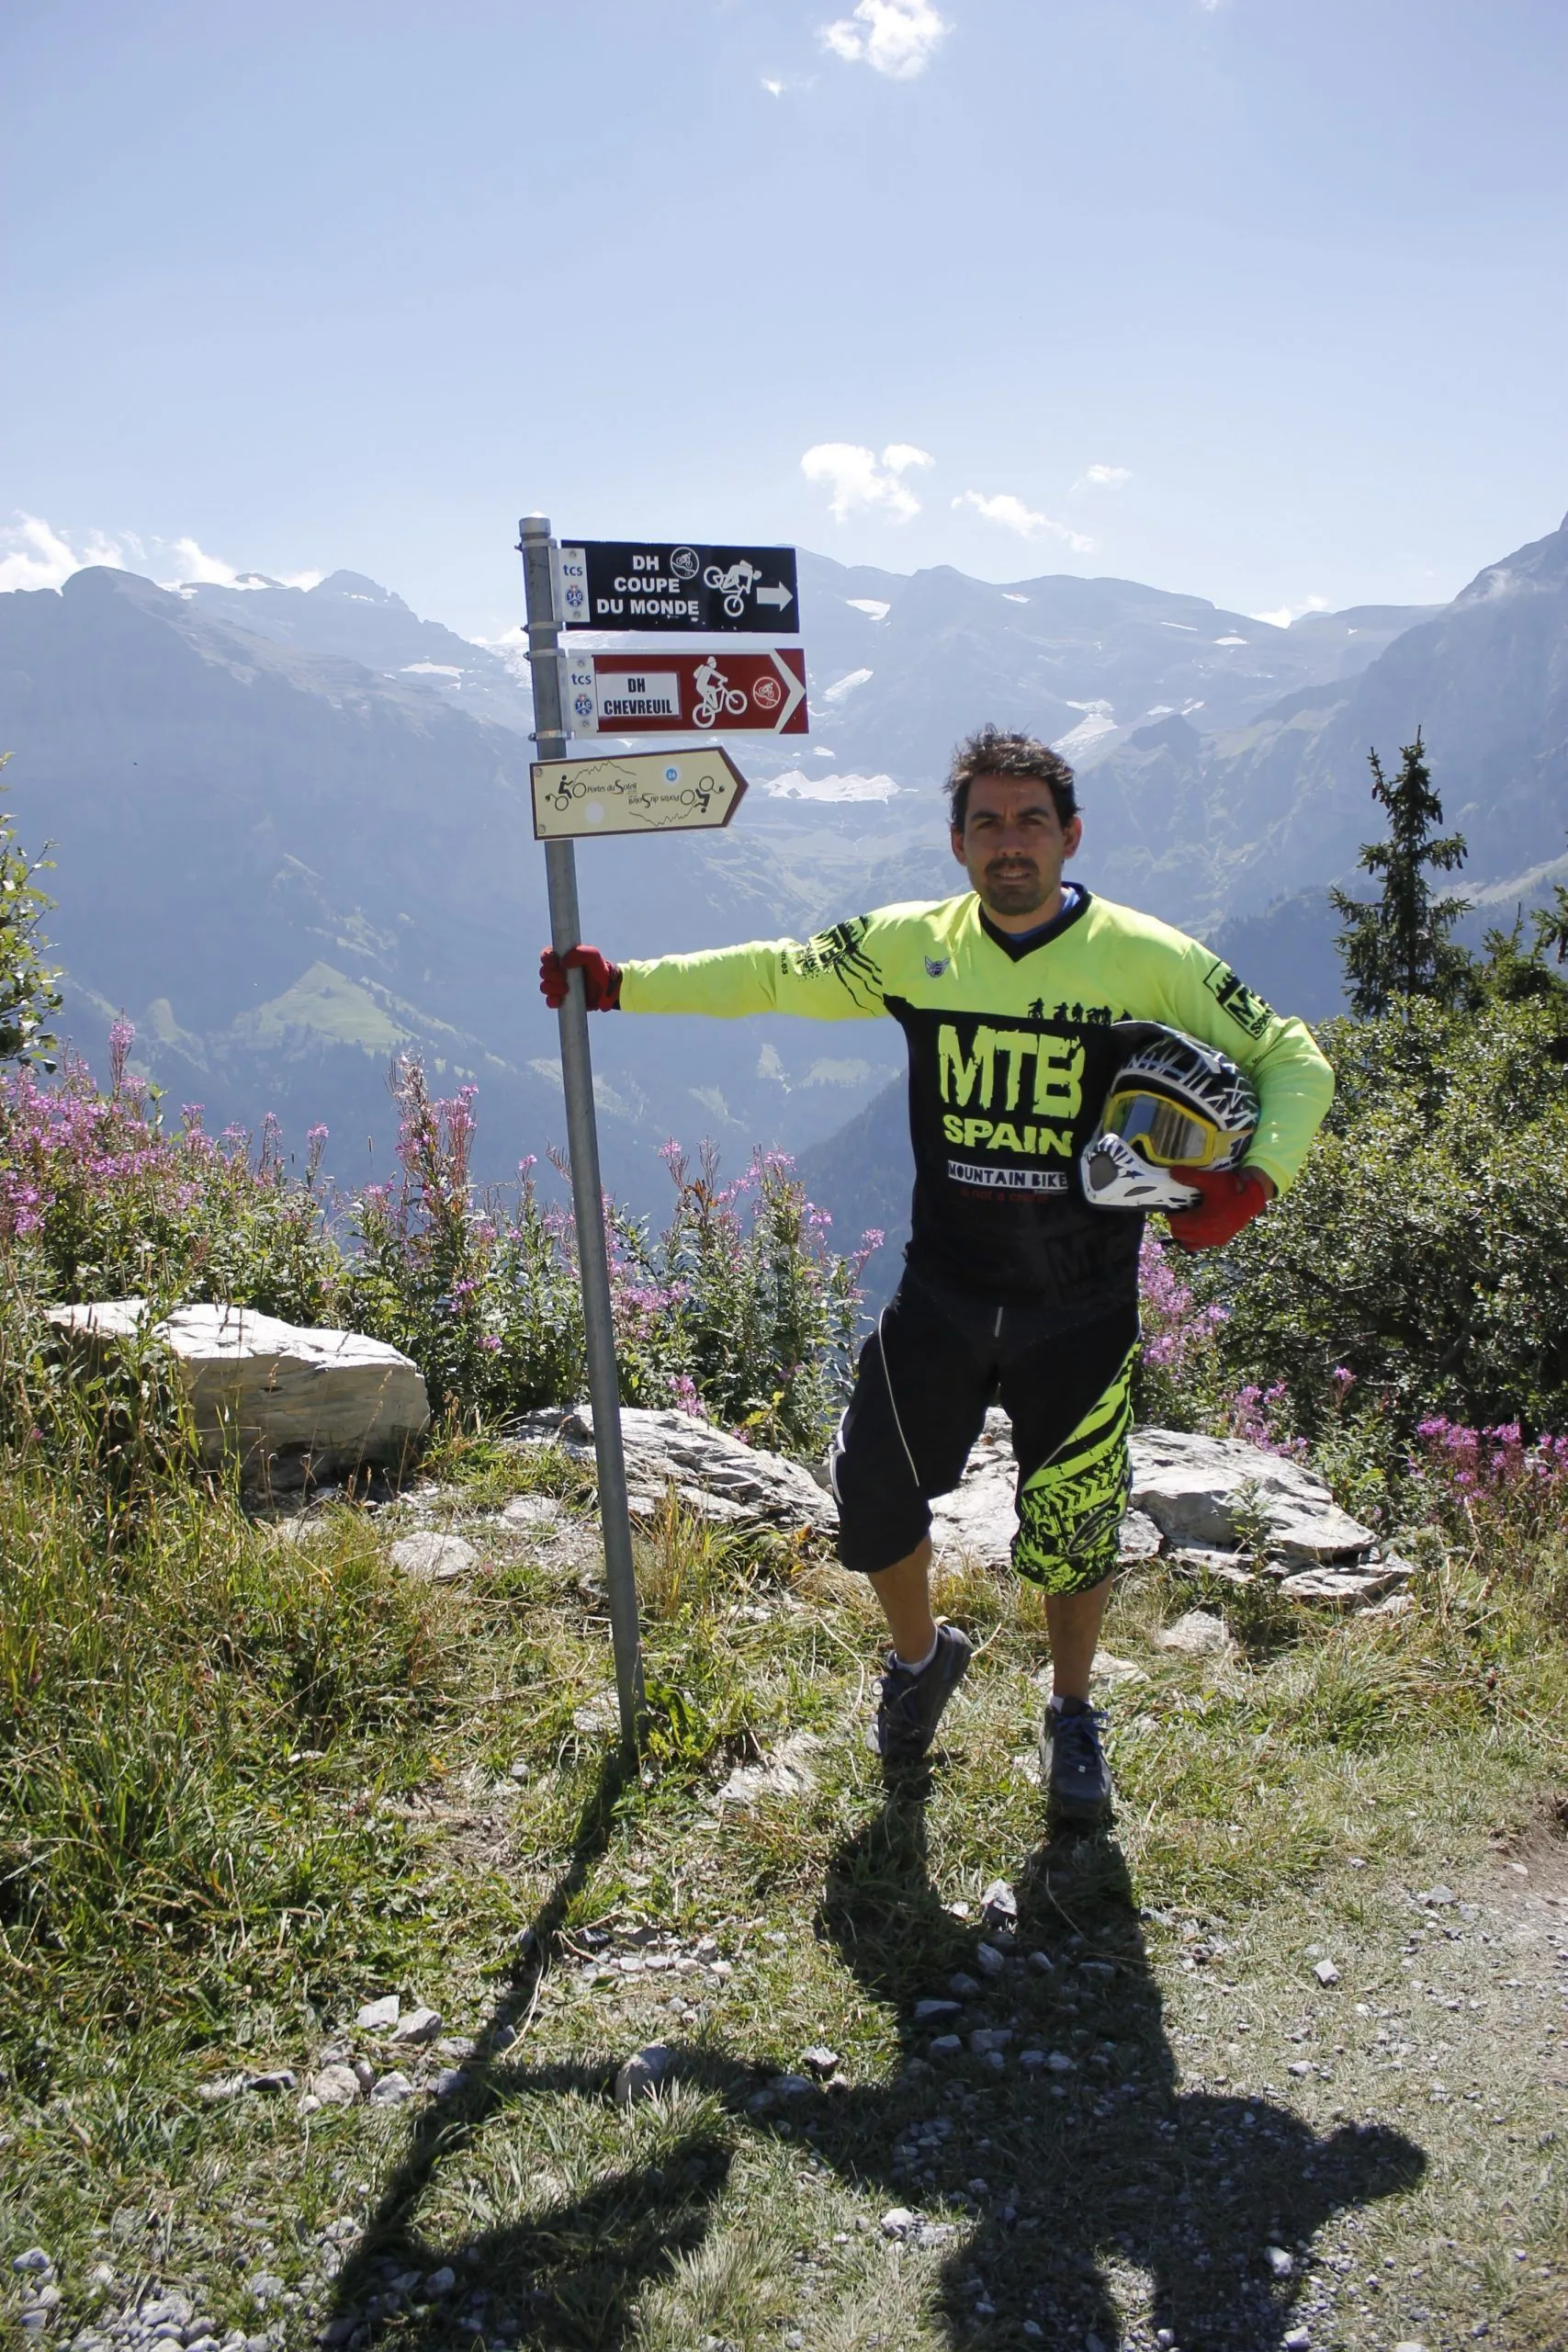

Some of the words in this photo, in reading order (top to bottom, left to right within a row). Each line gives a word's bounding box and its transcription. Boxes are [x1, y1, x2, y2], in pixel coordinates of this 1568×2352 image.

[562, 564, 583, 576] tcs
[632, 554, 660, 571] DH
[614, 577, 681, 593] COUPE
[597, 598, 624, 614] DU
[630, 599, 700, 616] MONDE
[570, 673, 592, 685] tcs
[627, 677, 646, 693] DH
[604, 698, 672, 715] CHEVREUIL
[587, 785, 606, 794] Portes
[606, 784, 615, 792] du
[938, 1023, 1086, 1119] MTB
[942, 1114, 1074, 1158] SPAIN
[948, 1161, 1026, 1186] MOUNTAIN
[1032, 1172, 1067, 1188] BIKE
